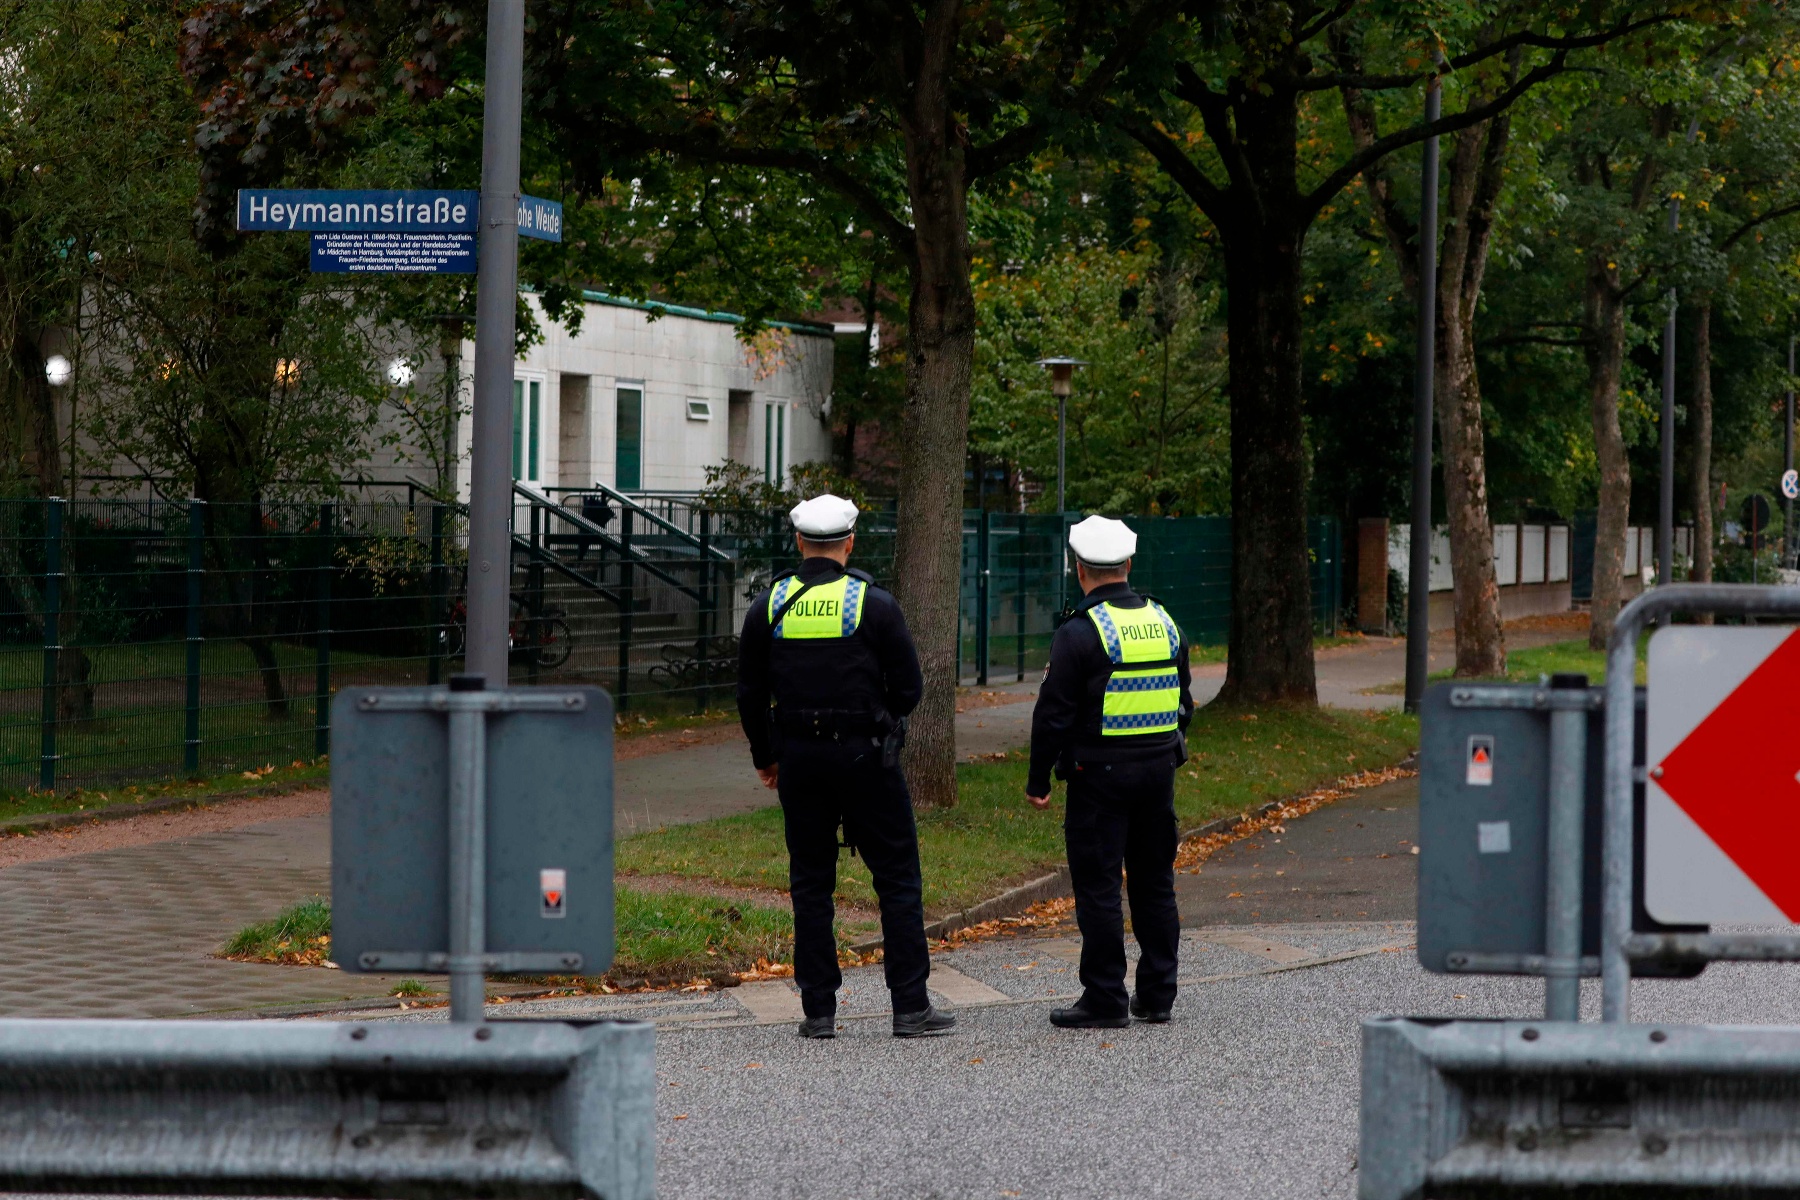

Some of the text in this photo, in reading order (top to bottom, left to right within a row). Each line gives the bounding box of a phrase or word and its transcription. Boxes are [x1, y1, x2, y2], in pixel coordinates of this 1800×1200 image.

[250, 196, 467, 230] Heymannstraße
[517, 201, 560, 234] ohe Weide
[437, 256, 448, 264] des
[787, 600, 839, 617] POLIZEI
[1120, 623, 1165, 641] POLIZEI
